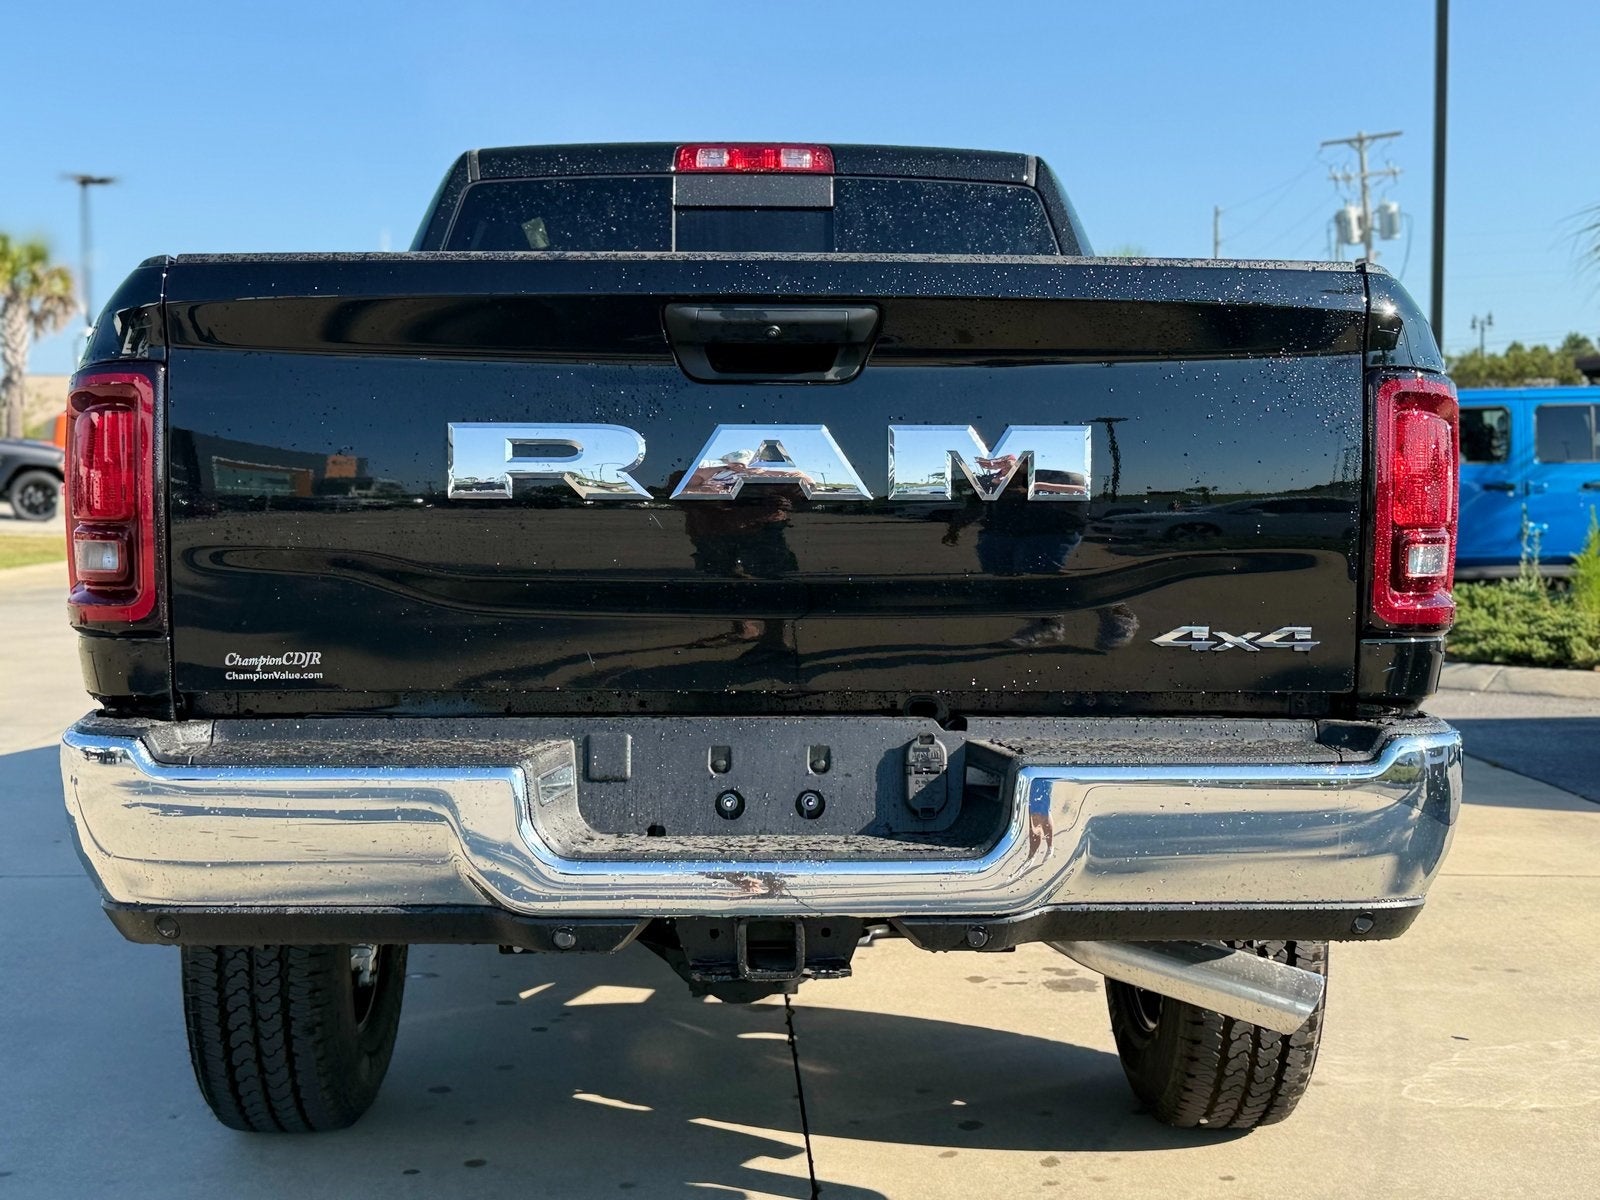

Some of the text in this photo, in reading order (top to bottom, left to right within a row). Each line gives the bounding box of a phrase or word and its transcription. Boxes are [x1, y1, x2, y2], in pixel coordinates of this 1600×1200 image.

[447, 422, 1092, 501] RAM
[1151, 626, 1321, 652] 4x4
[224, 652, 322, 671] ChampionCDJR
[225, 671, 323, 682] ChampionValue.com
